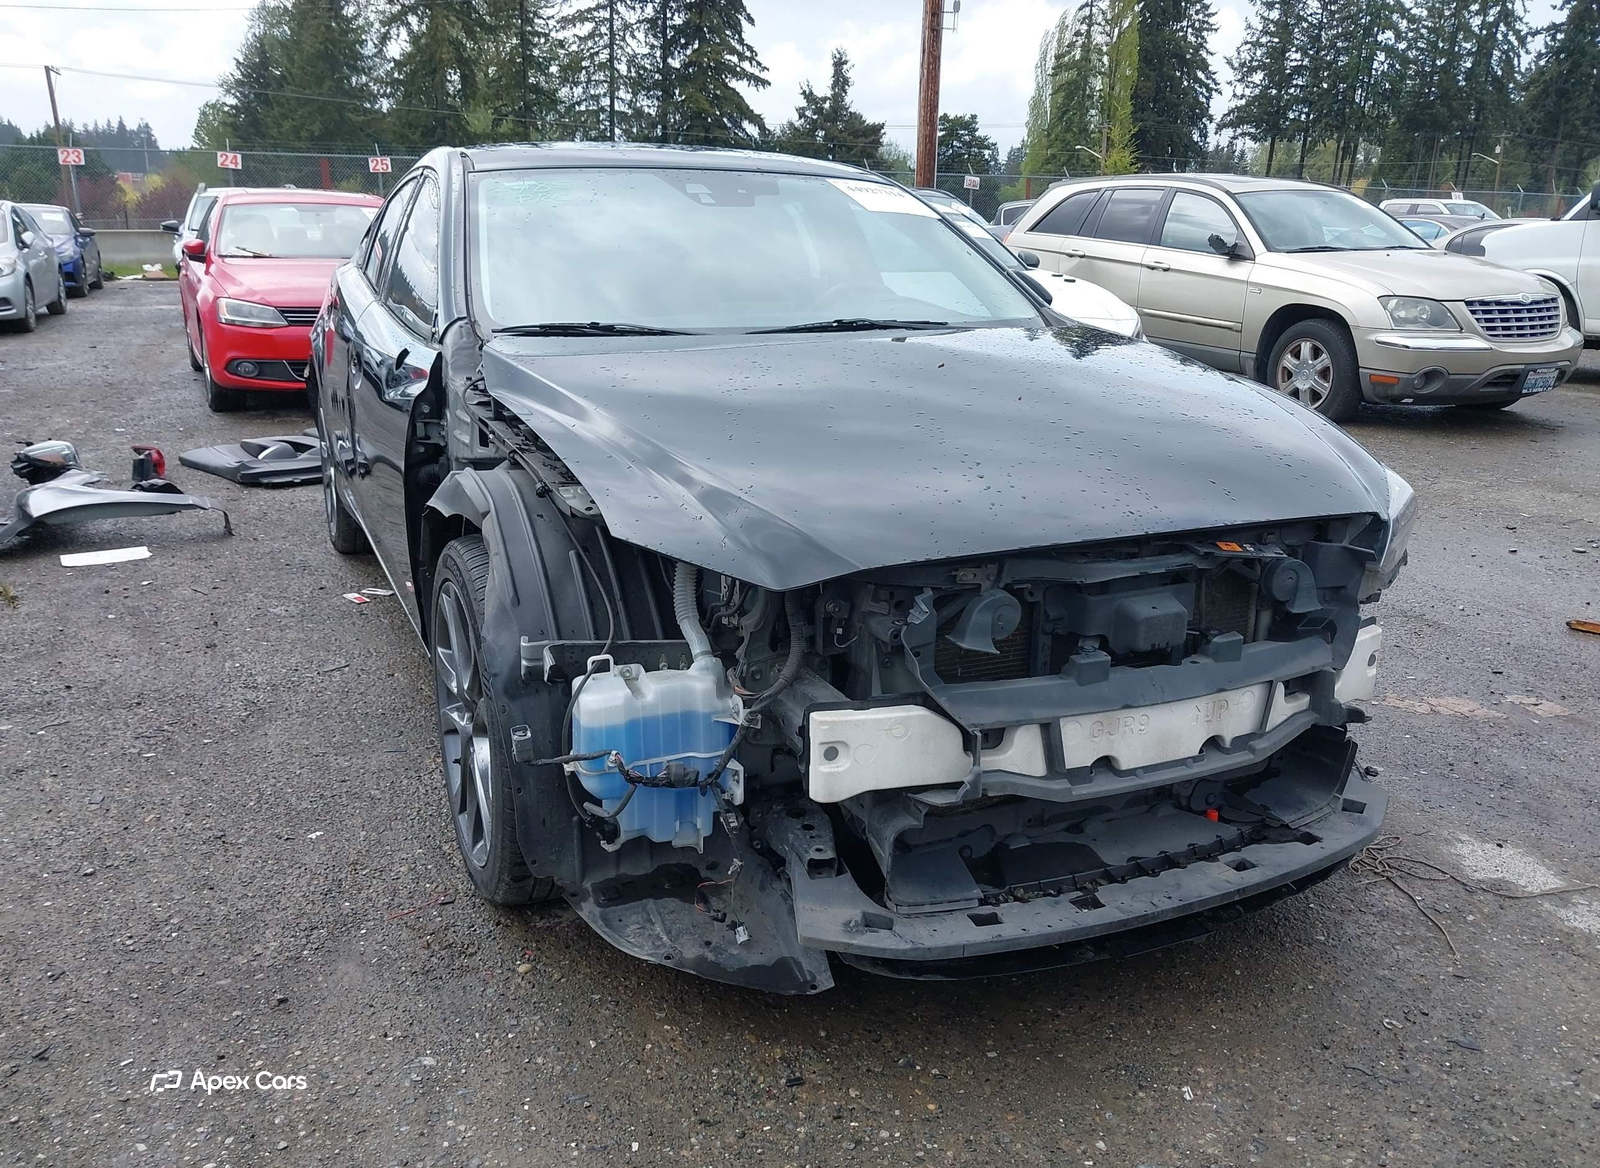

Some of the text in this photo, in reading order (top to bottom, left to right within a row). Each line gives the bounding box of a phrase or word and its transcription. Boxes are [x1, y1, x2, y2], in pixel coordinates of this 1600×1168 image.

[61, 149, 82, 163] 23
[219, 153, 239, 167] 24
[371, 158, 389, 172] 25
[1090, 713, 1150, 739] GJR9
